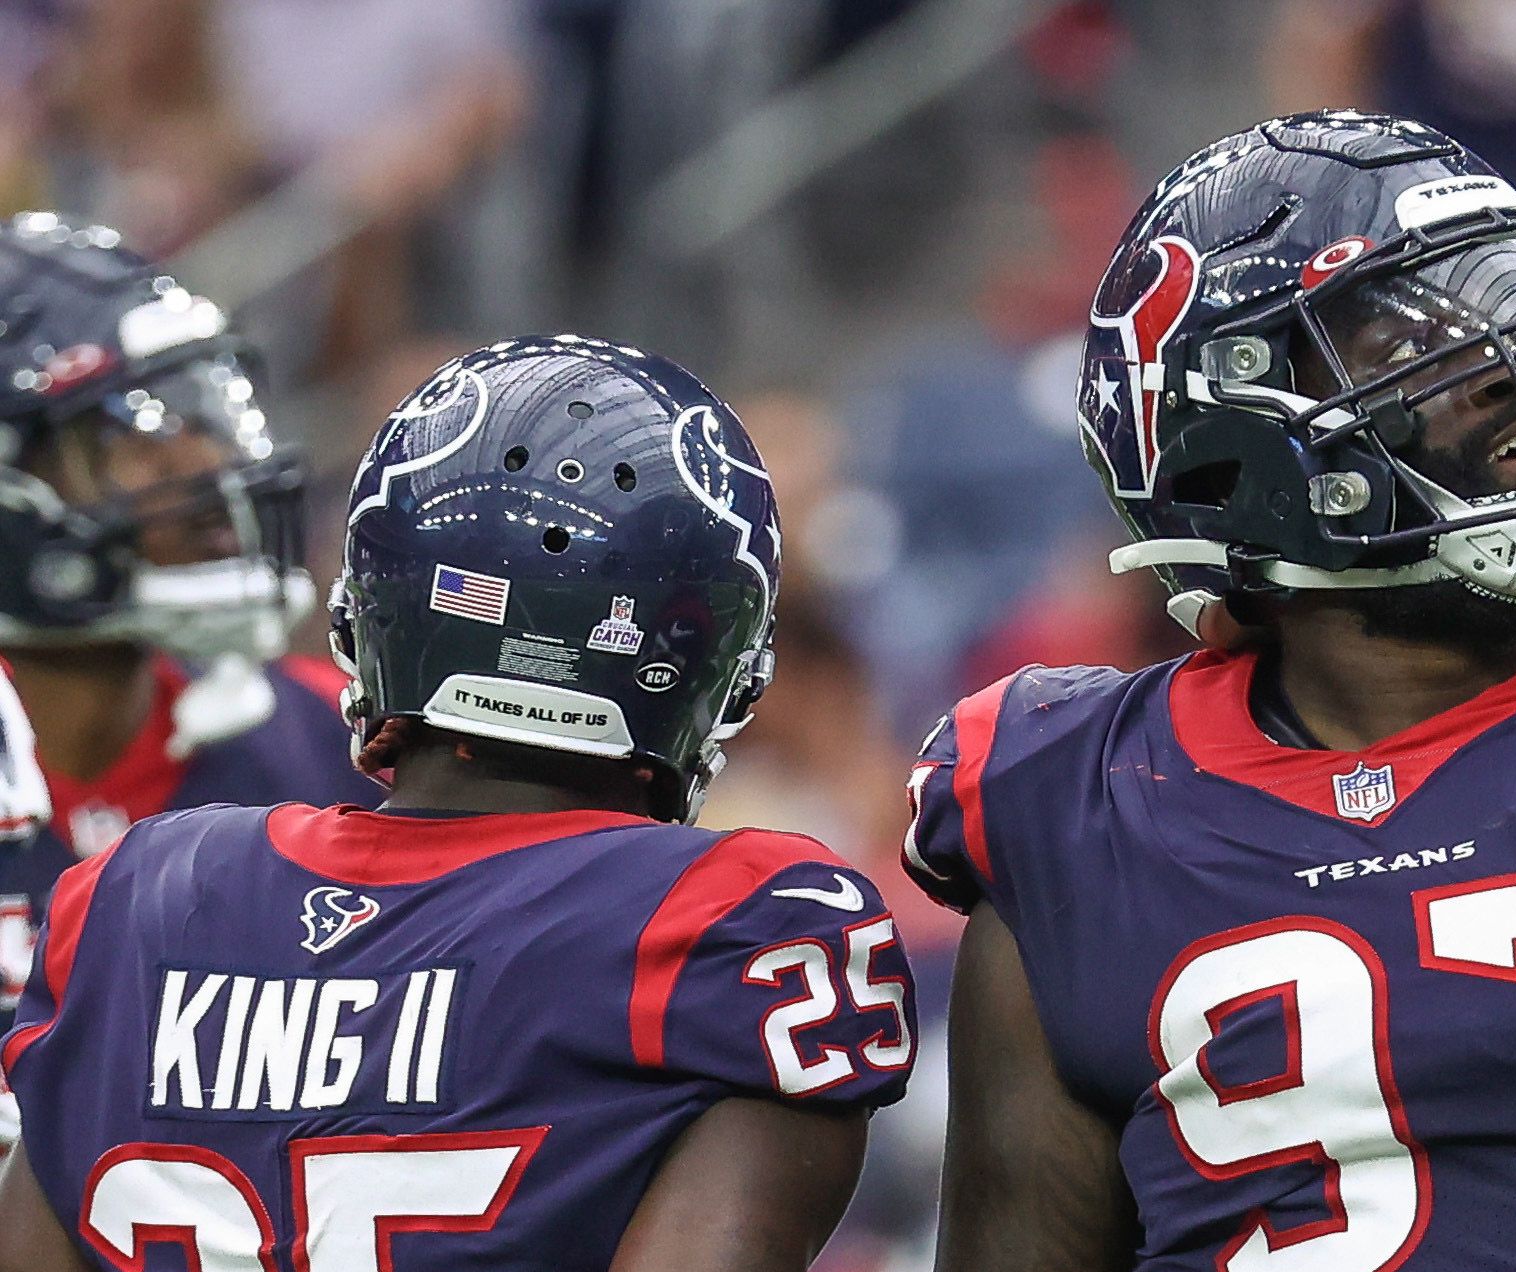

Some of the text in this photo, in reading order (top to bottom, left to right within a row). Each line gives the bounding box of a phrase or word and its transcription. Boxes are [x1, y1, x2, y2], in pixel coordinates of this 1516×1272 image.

[592, 628, 641, 647] CATCH
[602, 621, 636, 632] CRUCIAL
[455, 689, 608, 726] IT TAKES ALL OF US
[1346, 786, 1386, 809] NFL
[1294, 840, 1476, 888] TEXANS
[742, 911, 916, 1099] 25
[150, 968, 457, 1111] KING II
